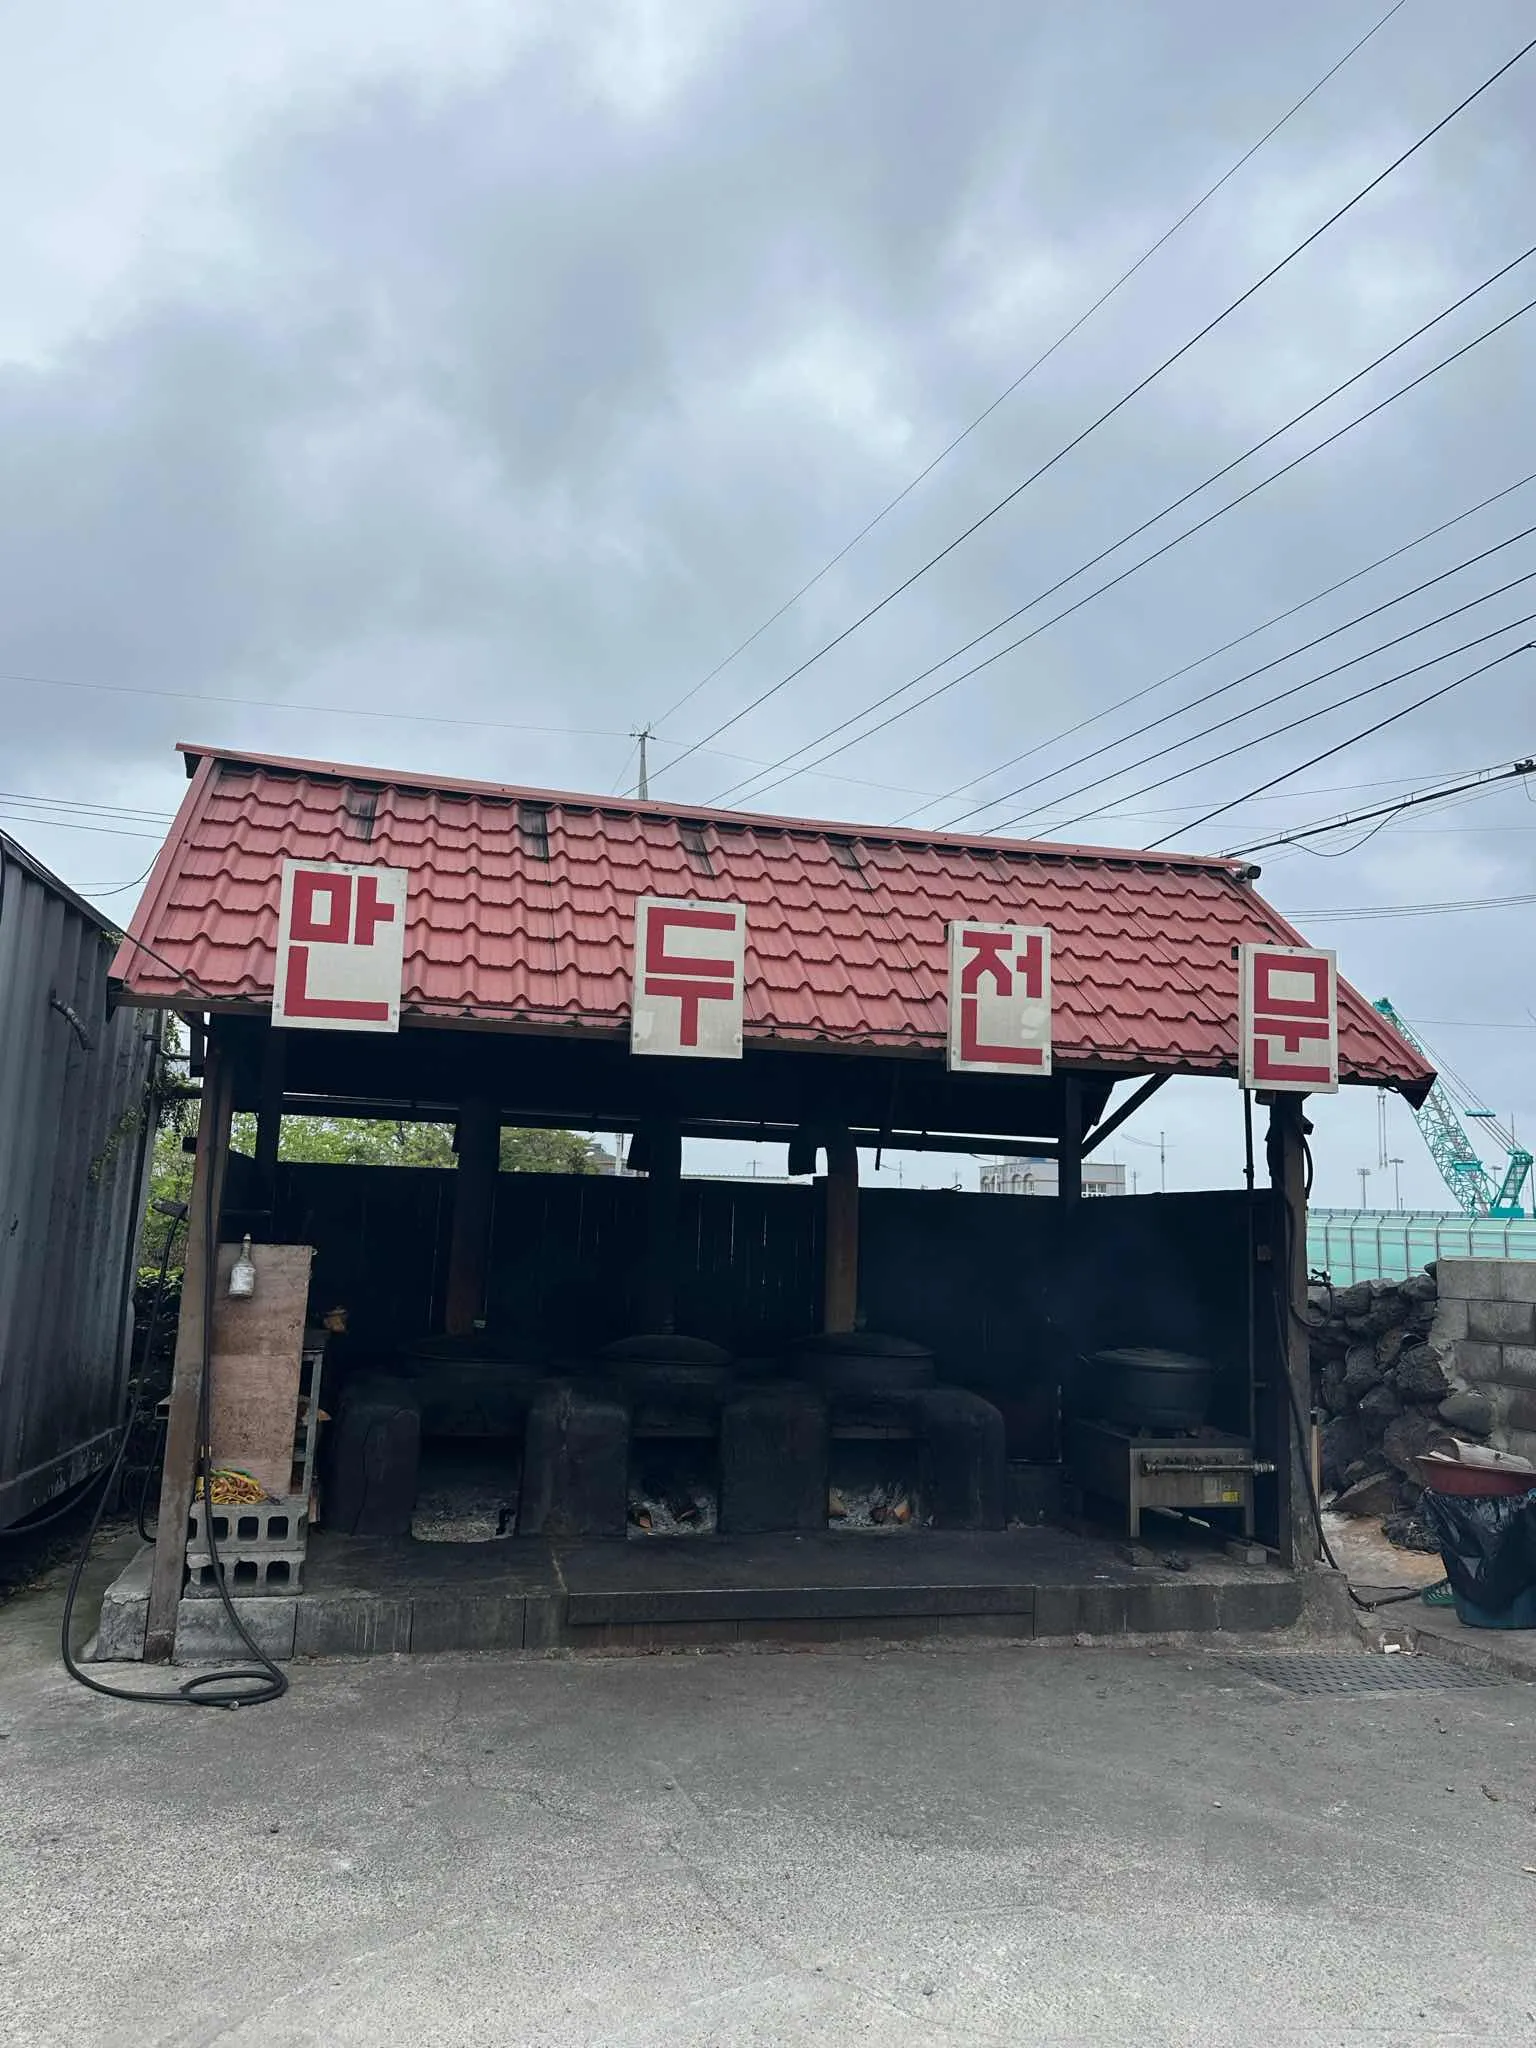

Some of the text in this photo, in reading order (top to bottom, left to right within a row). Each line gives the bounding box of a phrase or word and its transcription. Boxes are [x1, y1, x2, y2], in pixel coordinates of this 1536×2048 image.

[284, 868, 1330, 1083] 만 두 전 문
